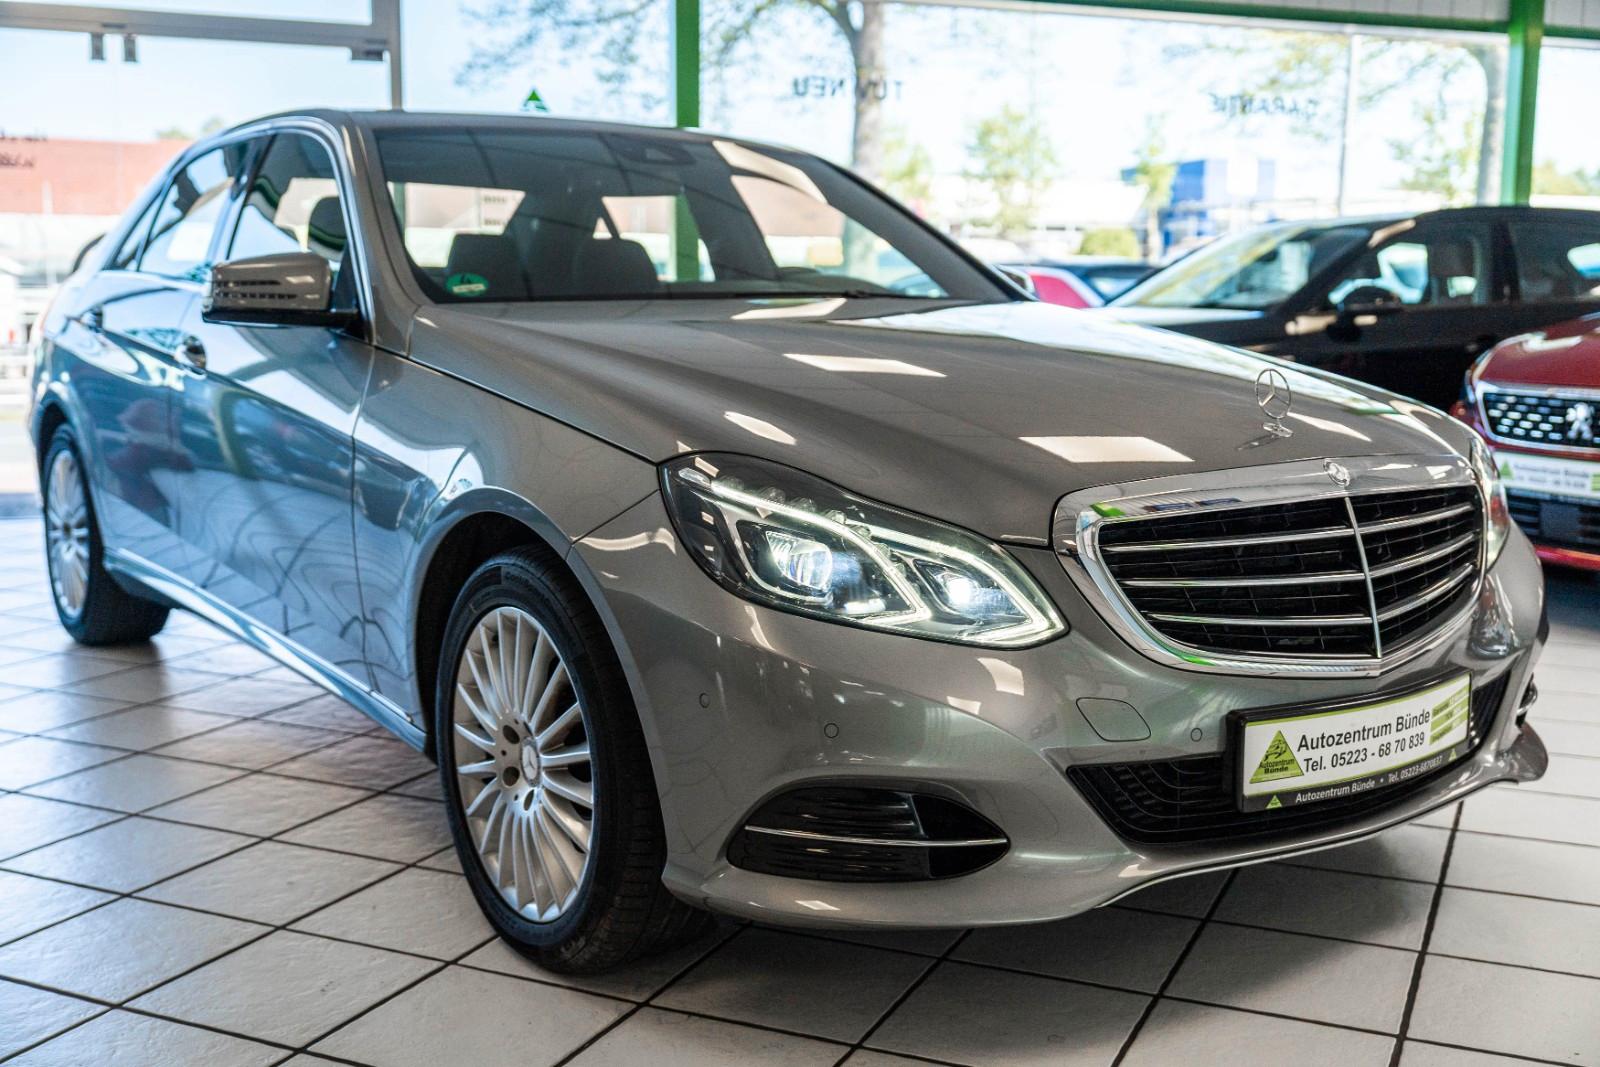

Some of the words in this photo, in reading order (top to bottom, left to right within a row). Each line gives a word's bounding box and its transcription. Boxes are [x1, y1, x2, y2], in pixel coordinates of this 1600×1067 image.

[1297, 722, 1391, 752] Autozentrum
[1396, 709, 1430, 733] Bünde
[1303, 756, 1326, 772] Tel.
[1331, 747, 1367, 768] 05223
[1378, 742, 1391, 758] 68
[1394, 738, 1406, 753] 70
[1409, 731, 1425, 749] 839
[1295, 786, 1350, 803] Autozentrum
[1351, 779, 1376, 793] Bünde
[1388, 771, 1399, 783] Tel.
